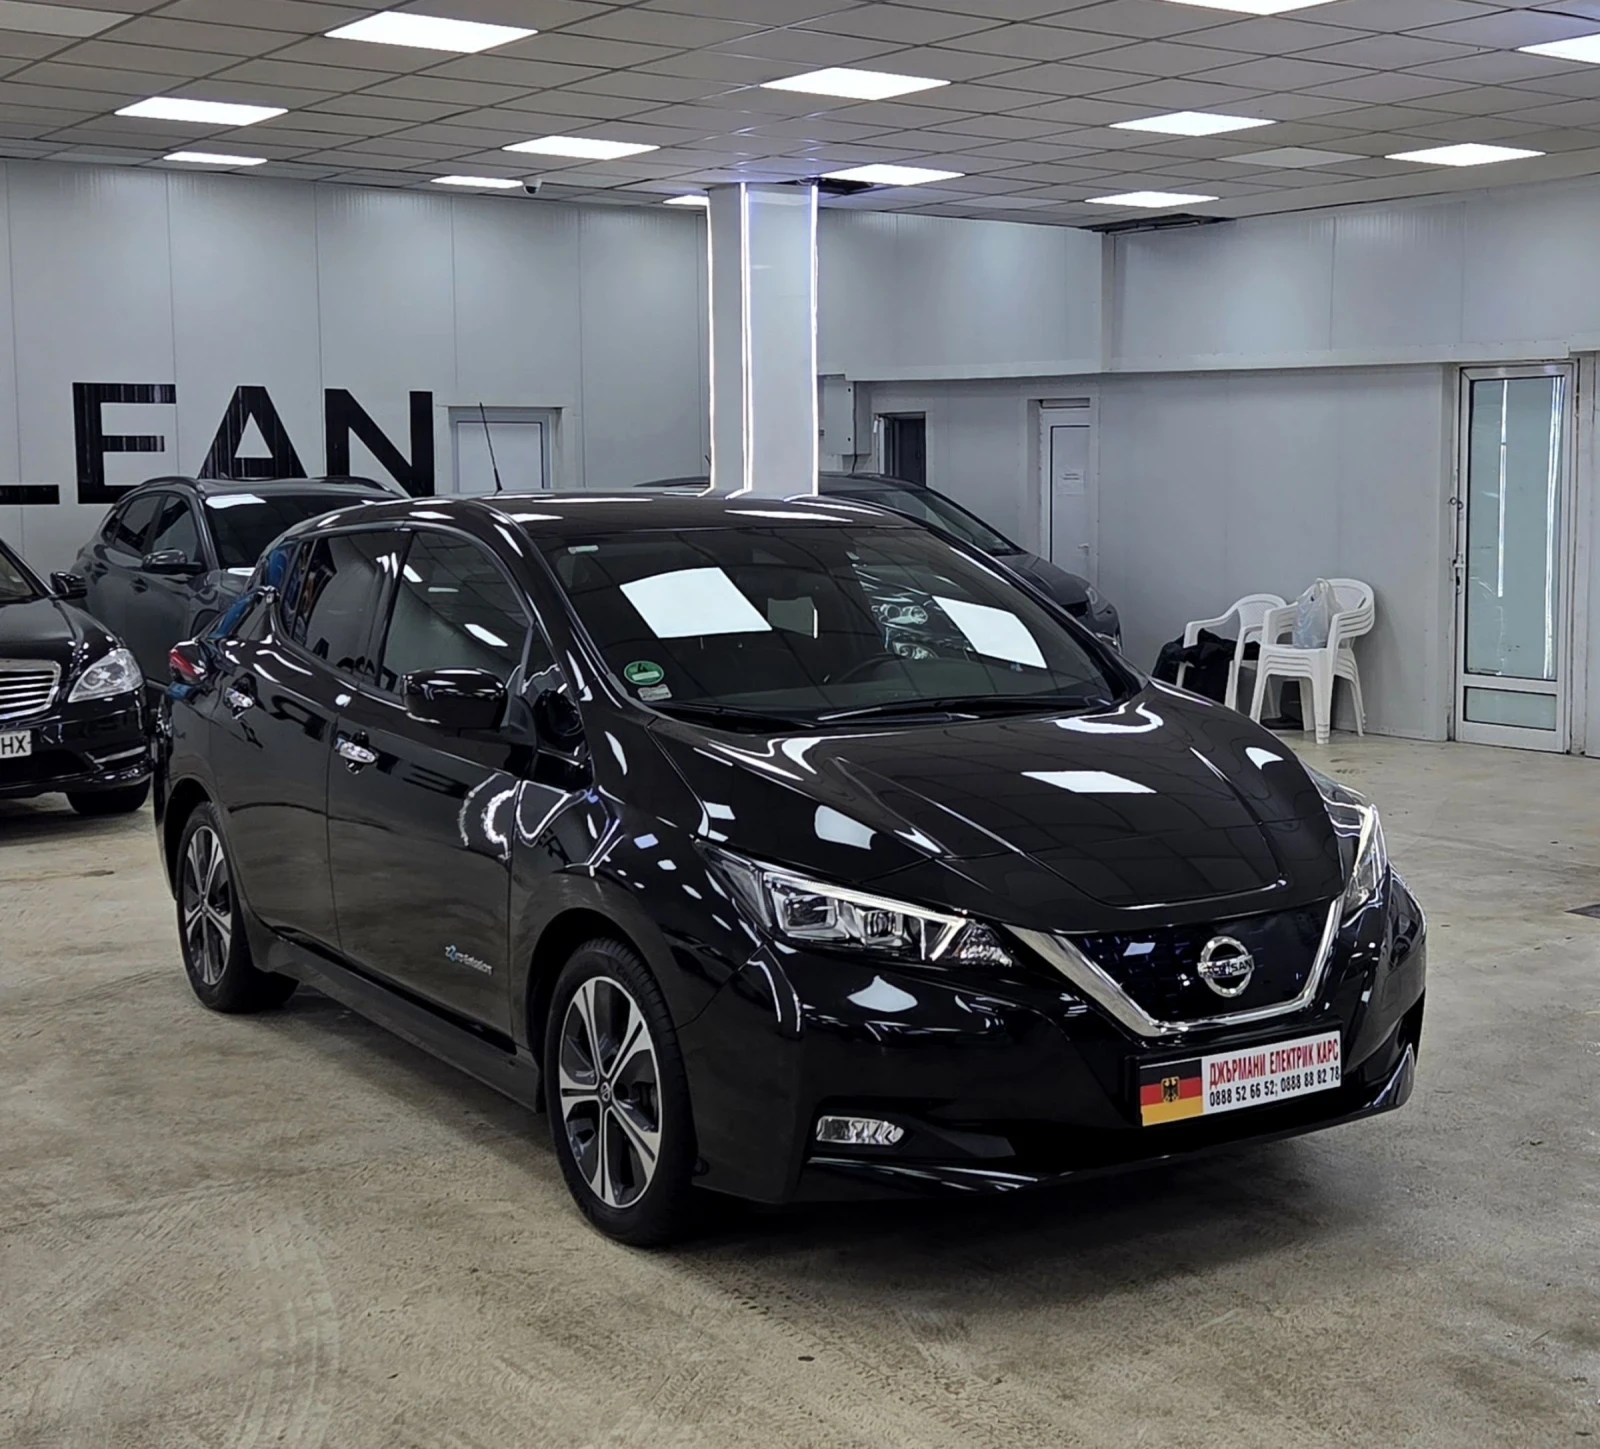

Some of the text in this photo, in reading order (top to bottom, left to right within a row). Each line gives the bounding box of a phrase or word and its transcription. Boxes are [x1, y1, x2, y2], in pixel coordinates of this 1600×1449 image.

[1209, 1038, 1339, 1090] ДЖЪРМАНИ ЕЛЕКТРИК КАРС
[1209, 1065, 1340, 1107] 0888 52 66 52; 0888 88 82 78
